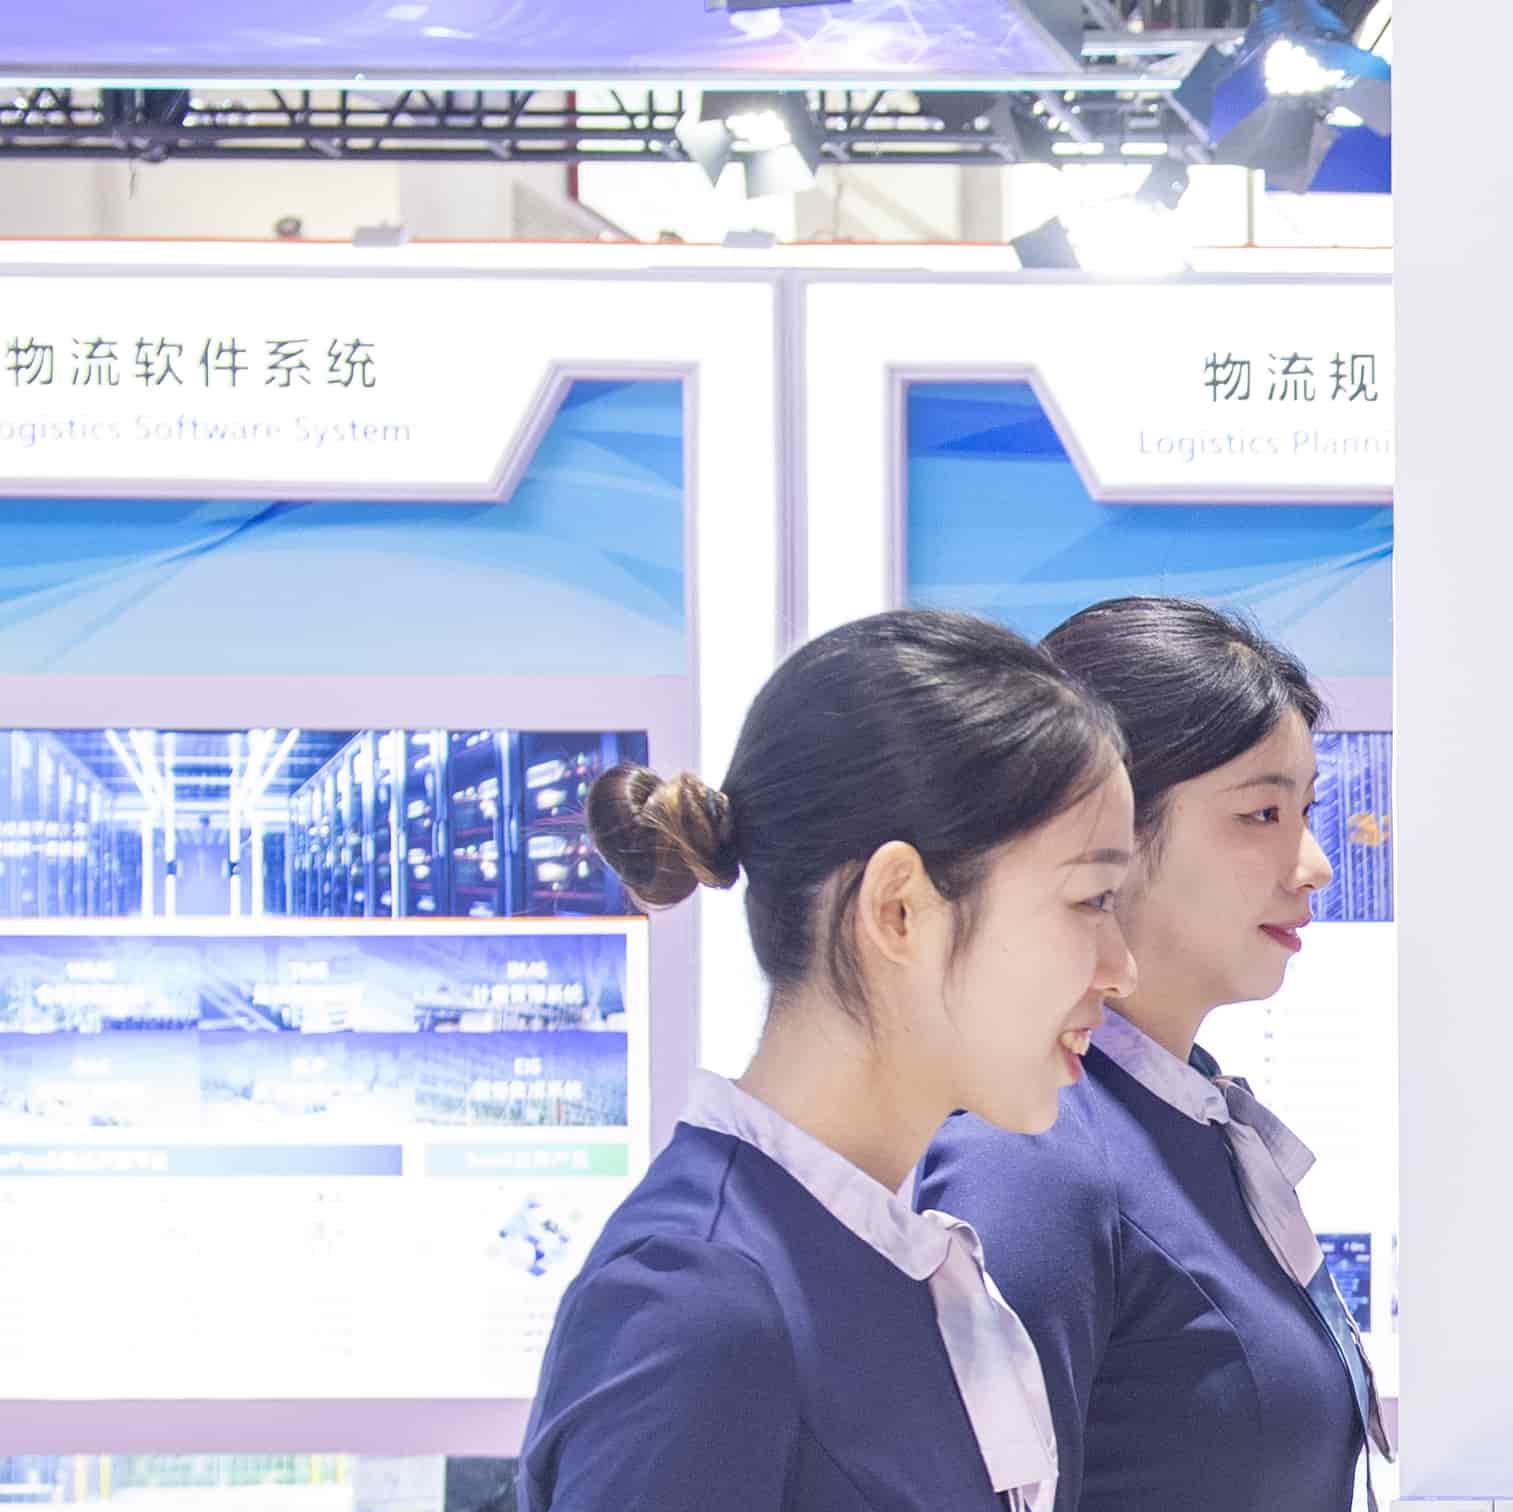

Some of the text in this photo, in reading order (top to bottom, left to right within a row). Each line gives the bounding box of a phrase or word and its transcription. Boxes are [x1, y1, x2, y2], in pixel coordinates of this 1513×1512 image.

[6, 336, 377, 388] 物流软件系统
[1204, 352, 1378, 402] 物流规
[0, 414, 412, 449] ogistics Software System
[1139, 427, 1390, 463] Logistics Planni
